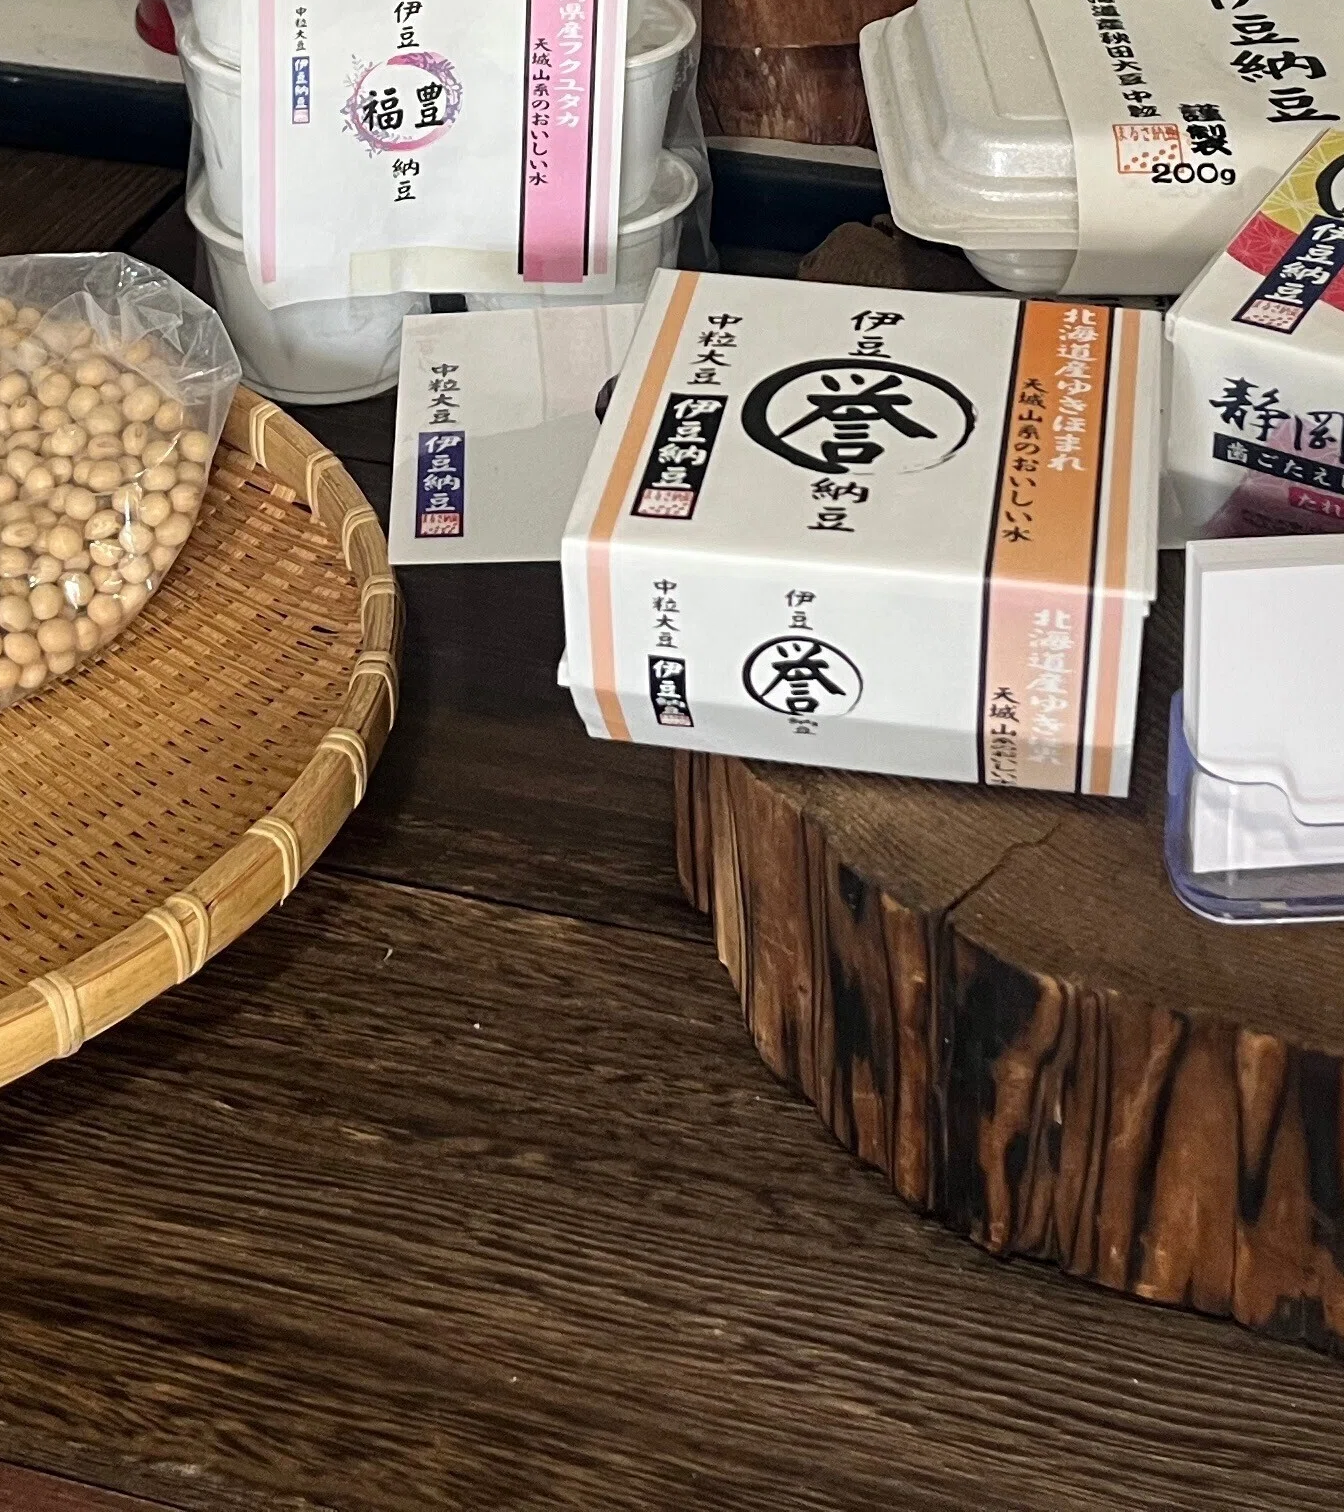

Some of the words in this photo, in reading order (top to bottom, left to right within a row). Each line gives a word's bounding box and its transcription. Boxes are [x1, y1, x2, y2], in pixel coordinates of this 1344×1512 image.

[393, 0, 424, 50] 伊豆
[294, 58, 310, 110] 伊豆納豆
[529, 37, 553, 186] 天城山系のおいしい水
[391, 157, 421, 203] 納豆
[1150, 162, 1237, 186] 200g
[686, 313, 744, 386] 中粒大豆
[848, 309, 905, 359] 伊豆
[428, 363, 461, 425] 中粒大豆
[777, 373, 938, 464] 誉
[1046, 308, 1099, 472] 北海道産ゆきほまれ
[423, 435, 463, 513] 伊豆納豆
[651, 398, 723, 489] 伊豆納豆
[1002, 377, 1050, 543] 天城山系のおいしい水
[806, 477, 870, 533] 納豆
[652, 578, 681, 649] 中粒大豆
[784, 588, 817, 631] 伊豆
[760, 642, 847, 714] 誉
